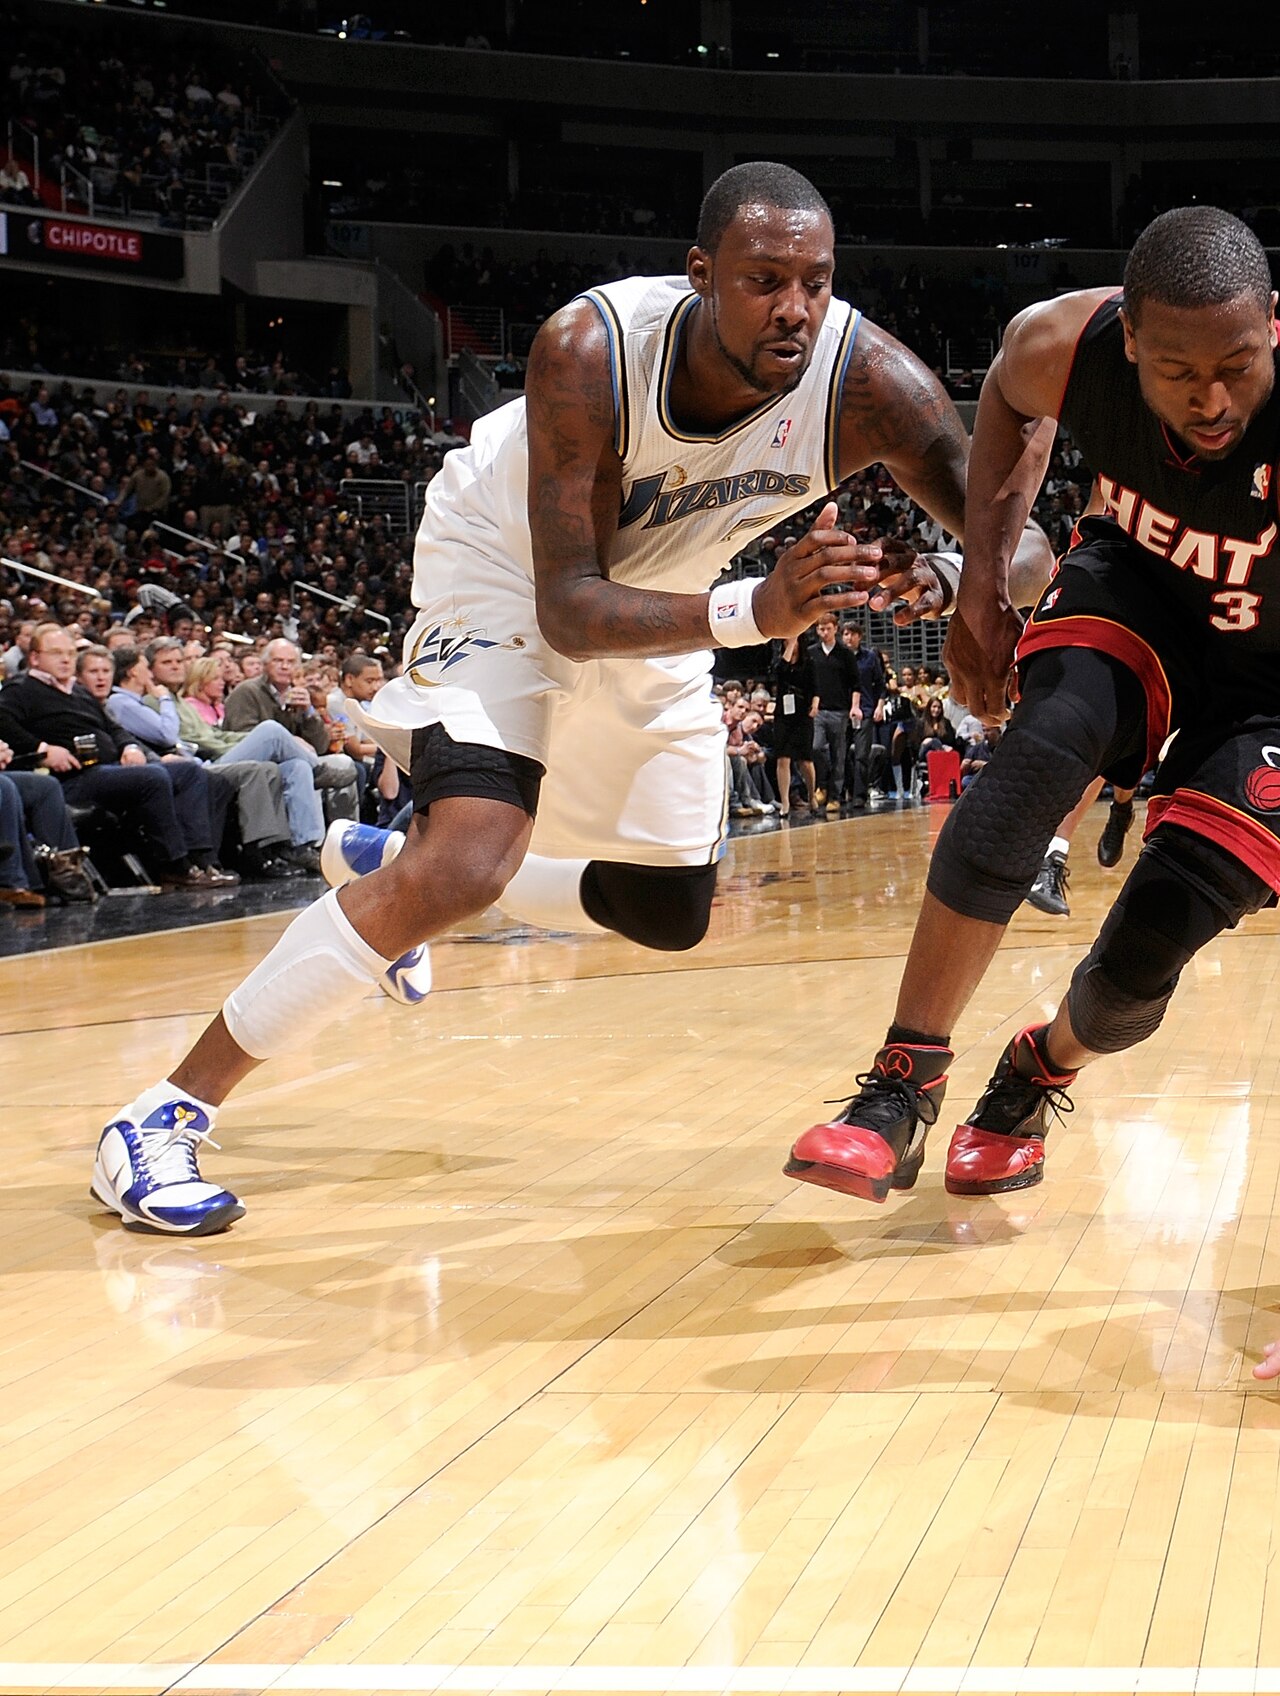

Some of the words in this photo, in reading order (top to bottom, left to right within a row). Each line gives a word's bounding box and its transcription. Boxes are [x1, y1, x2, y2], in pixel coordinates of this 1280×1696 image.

[48, 226, 139, 256] CHIPOTLE
[1013, 253, 1040, 268] 107
[1098, 471, 1279, 586] HEAT
[1209, 590, 1263, 632] 3
